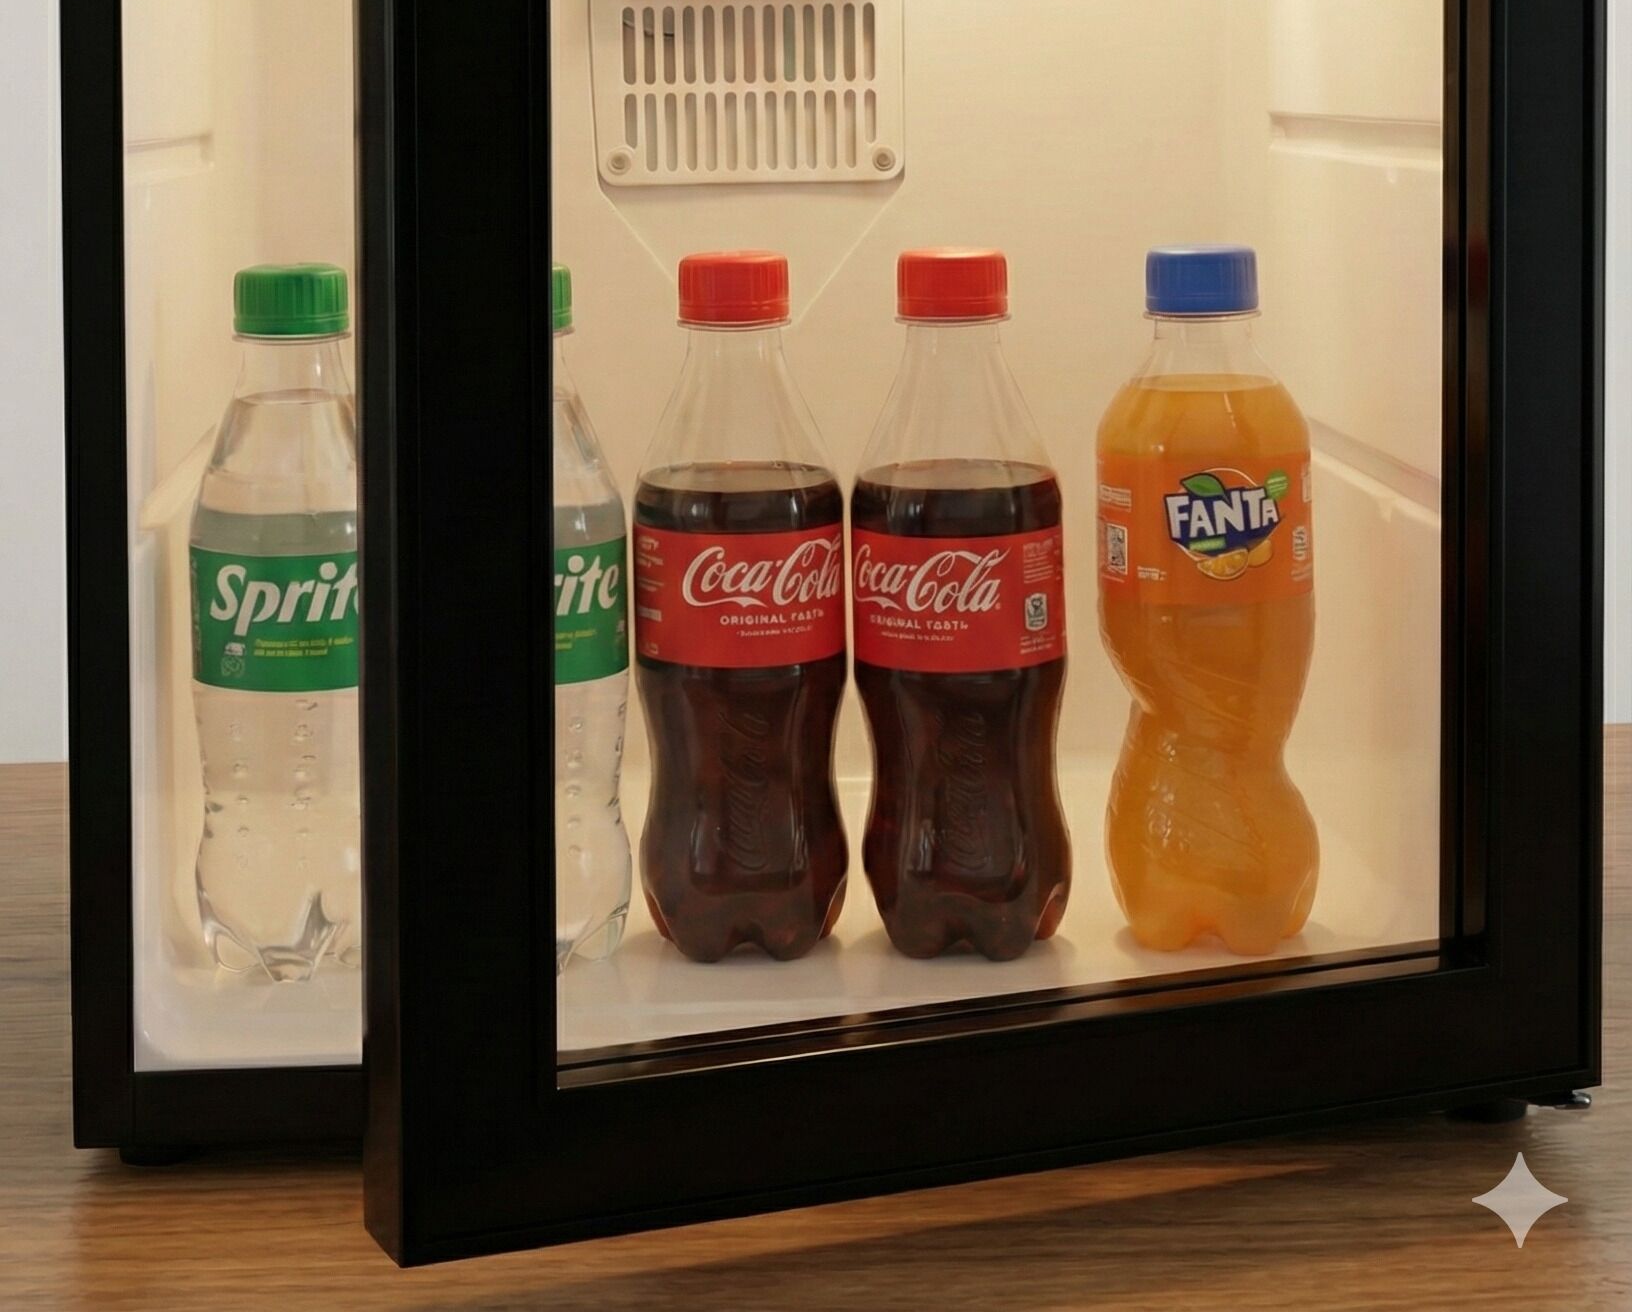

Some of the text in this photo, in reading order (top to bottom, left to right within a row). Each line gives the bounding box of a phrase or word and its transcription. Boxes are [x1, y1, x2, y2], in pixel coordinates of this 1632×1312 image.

[1165, 487, 1279, 539] FANTA
[210, 561, 359, 636] Sprit
[554, 554, 619, 616] ite
[854, 543, 1013, 613] Coca-Cola
[719, 613, 787, 626] ORIGINAL
